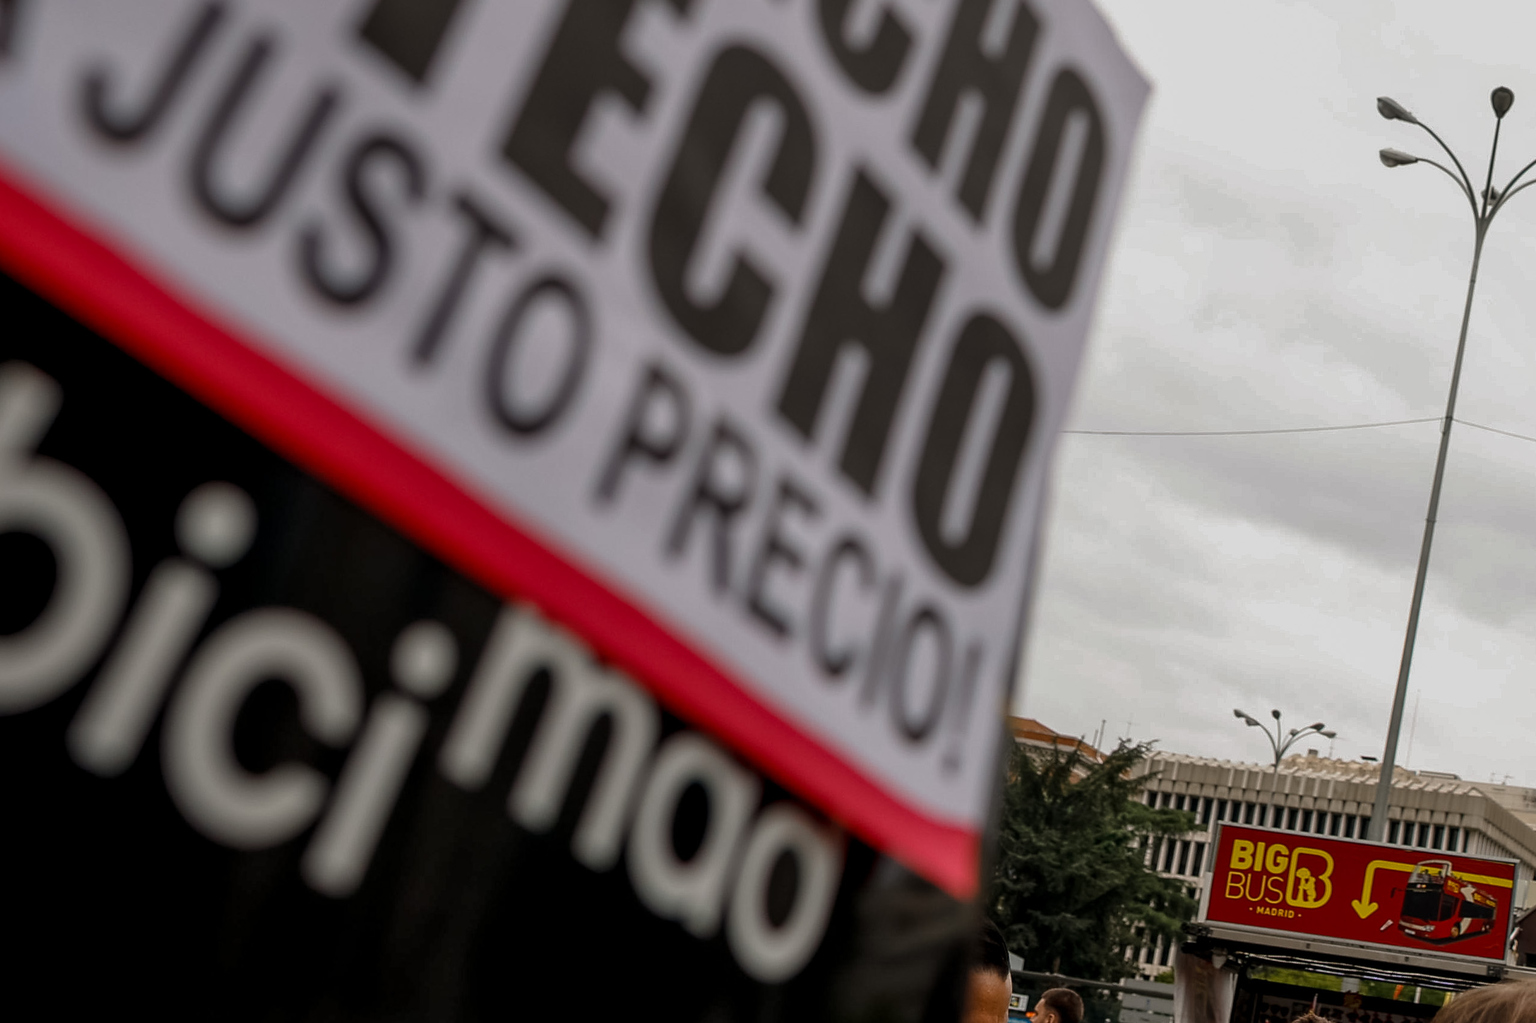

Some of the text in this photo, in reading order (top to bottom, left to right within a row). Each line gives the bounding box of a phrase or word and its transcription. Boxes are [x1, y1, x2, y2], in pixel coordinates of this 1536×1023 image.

[600, 356, 986, 771] PRECIO!
[1230, 839, 1289, 874] BIG
[1225, 871, 1285, 904] BUS
[1256, 906, 1295, 919] MADRID
